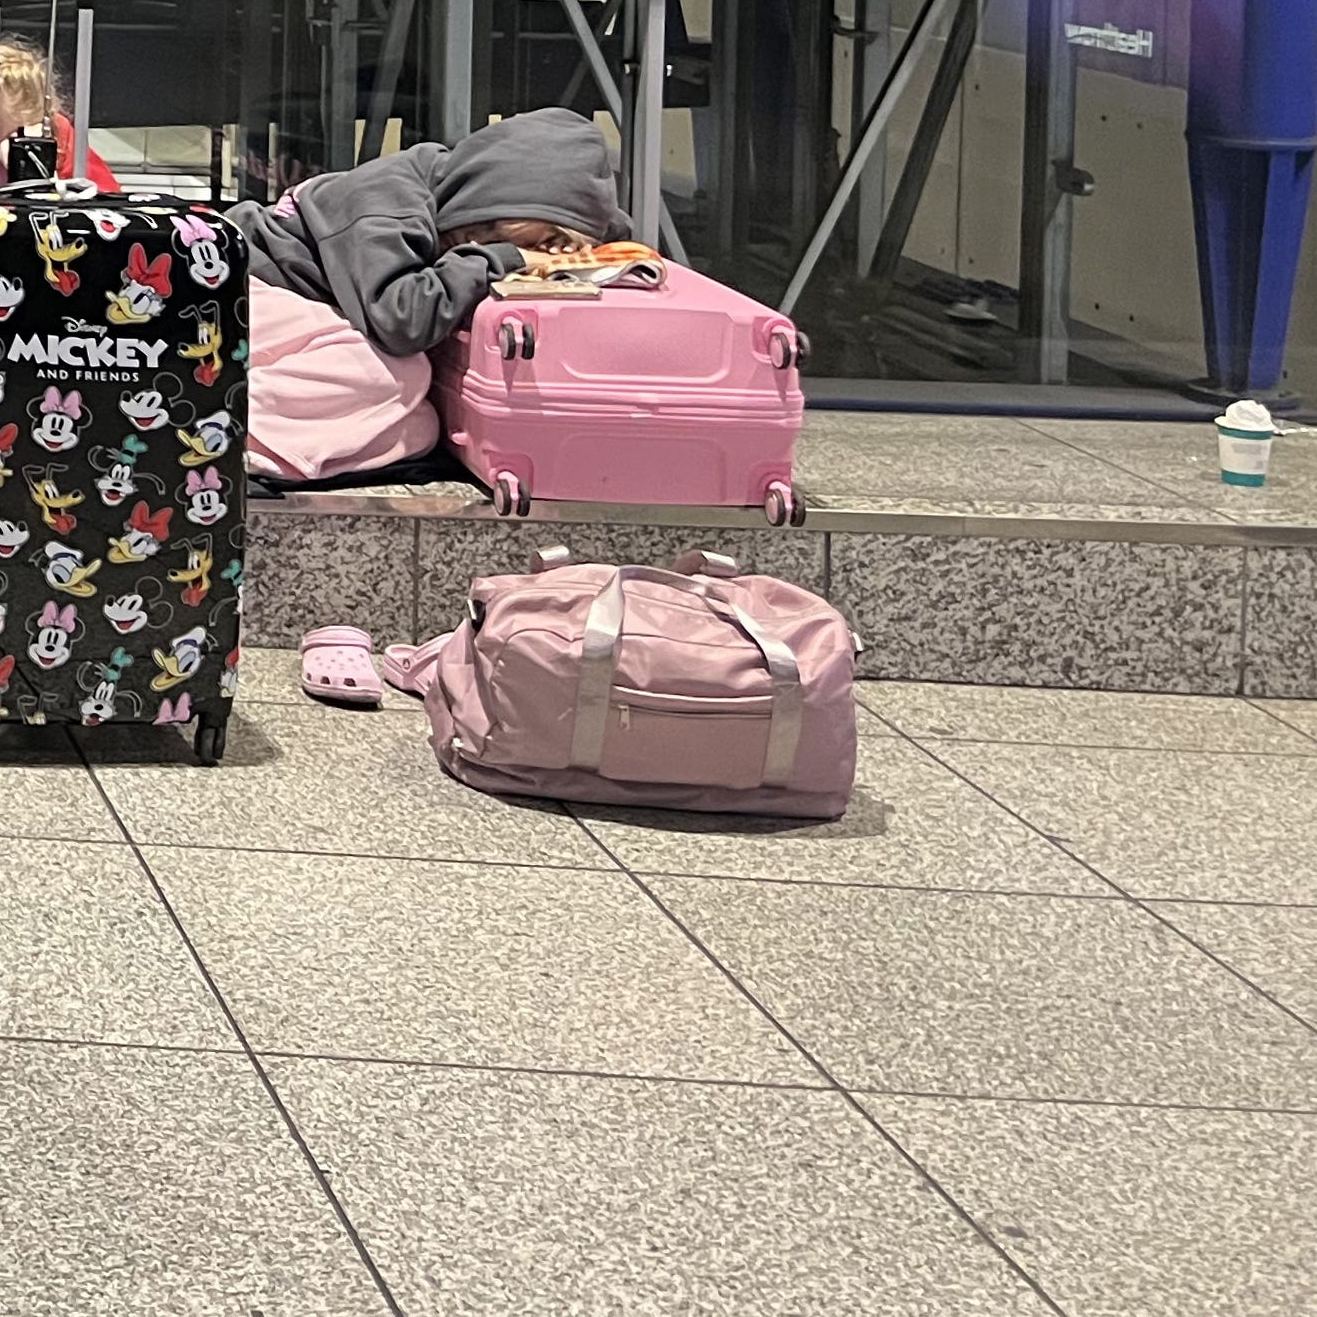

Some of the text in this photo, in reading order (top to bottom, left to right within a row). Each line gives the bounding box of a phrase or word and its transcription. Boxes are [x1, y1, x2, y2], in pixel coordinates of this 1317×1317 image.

[7, 333, 169, 368] MICKEY
[36, 369, 141, 382] AND FRIENDS
